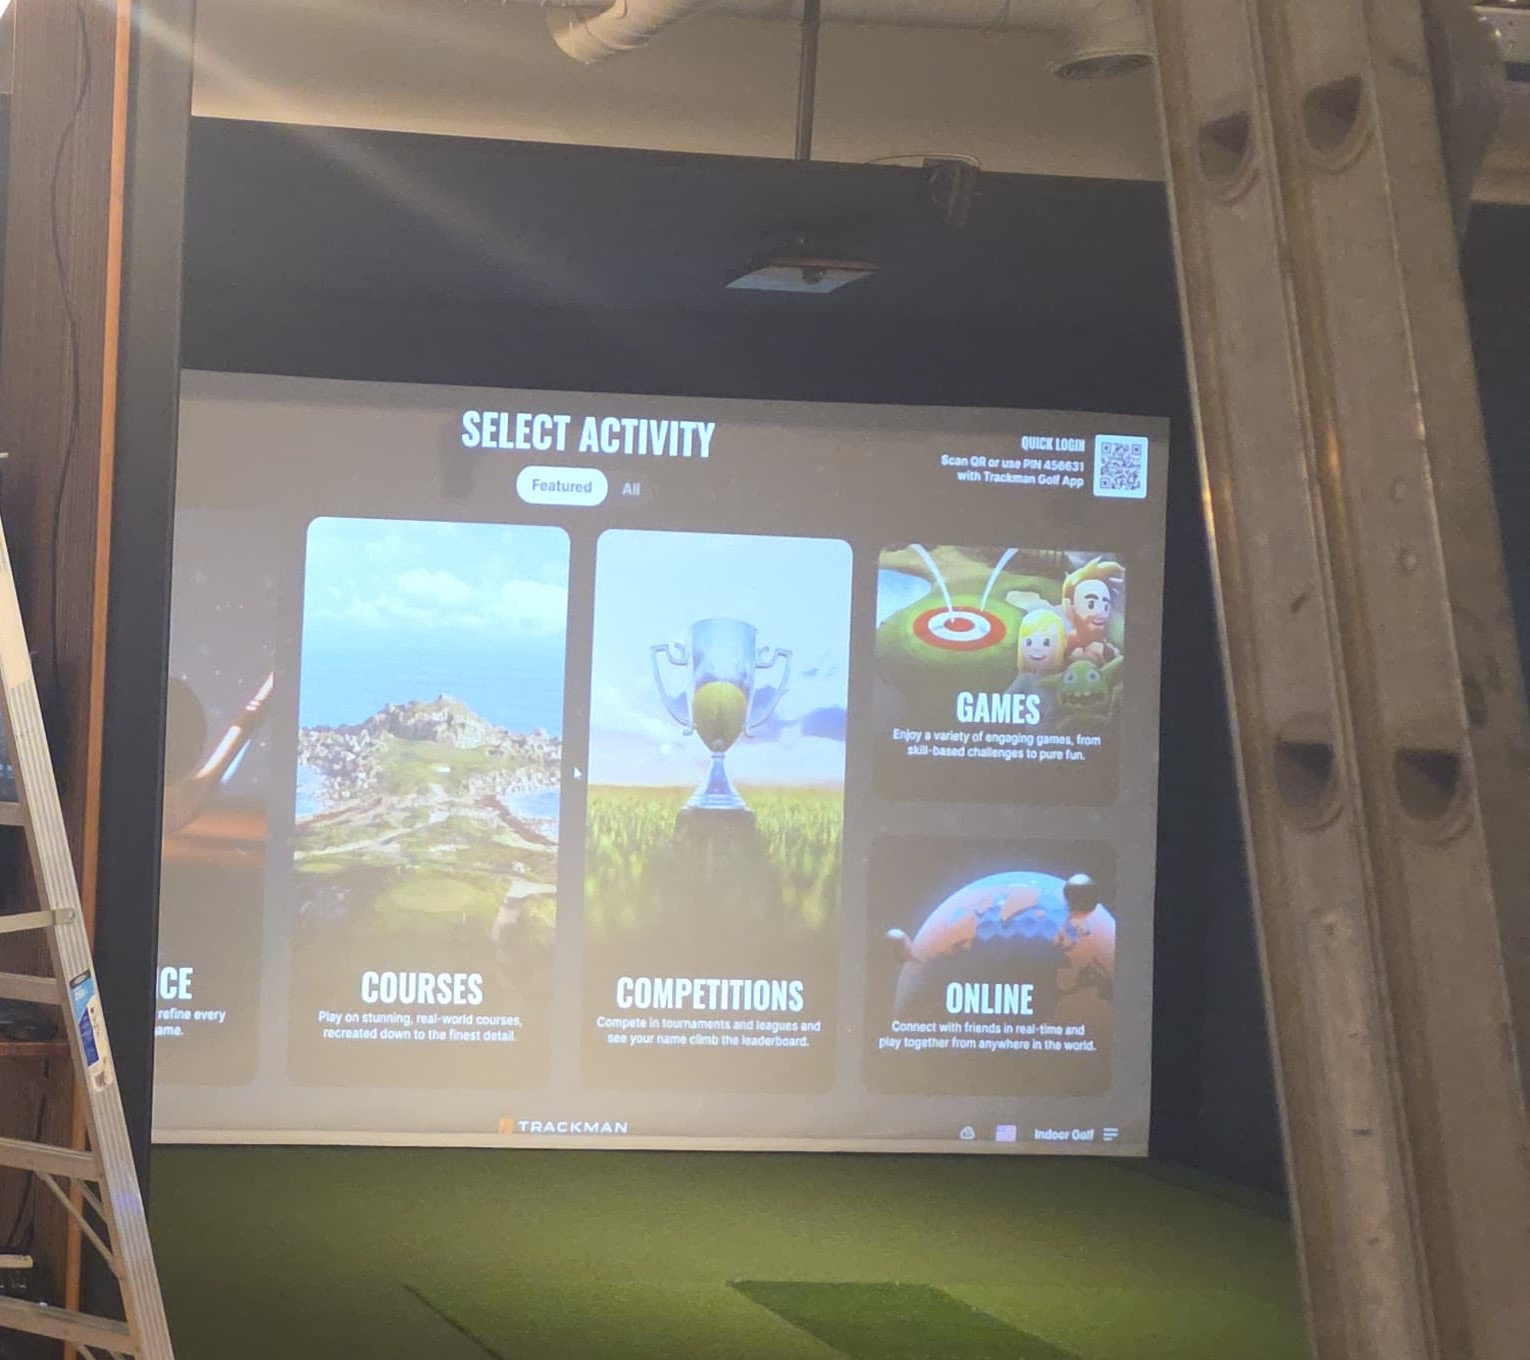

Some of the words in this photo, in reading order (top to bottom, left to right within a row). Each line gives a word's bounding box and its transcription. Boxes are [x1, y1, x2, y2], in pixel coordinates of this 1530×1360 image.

[461, 409, 571, 452] SELECT
[578, 416, 716, 459] ACTIVITY
[1021, 436, 1053, 452] QUICK
[1055, 438, 1086, 453] LOGIN
[941, 454, 968, 466] Scan
[970, 456, 987, 468] QR
[988, 459, 1000, 469] or
[1001, 460, 1021, 470] use
[1023, 459, 1042, 470] PIN
[532, 478, 593, 494] Featured
[622, 482, 640, 496] All
[957, 470, 981, 482] with
[983, 471, 1035, 485] Trackman
[1038, 474, 1060, 485] Golf
[1062, 475, 1084, 488] App
[956, 691, 1040, 725] GAMES
[893, 728, 922, 741] Enjoy
[925, 732, 931, 740] a
[933, 731, 970, 743] variety
[972, 731, 983, 742] of
[985, 733, 1034, 746] engaging
[1036, 734, 1074, 747] games,
[1076, 734, 1101, 745] from
[907, 745, 965, 757] skill-based
[966, 747, 1023, 761] challenges
[1026, 749, 1037, 758] to
[1039, 750, 1063, 762] pure
[1065, 749, 1085, 760] fun.
[361, 971, 483, 1005] COURSES
[616, 976, 804, 1012] COMPETITIONS
[945, 981, 1034, 1015] ONLINE
[158, 1007, 191, 1020] refine
[194, 1010, 226, 1023] every
[318, 1011, 342, 1024] Play
[345, 1014, 360, 1024] on
[362, 1012, 413, 1026] stunning,
[416, 1013, 473, 1025] real-world
[476, 1015, 522, 1027] courses,
[596, 1016, 646, 1031] Compete
[649, 1017, 660, 1028] in
[662, 1018, 731, 1030] tournaments
[733, 1019, 754, 1030] and
[755, 1020, 798, 1033] leagues
[800, 1021, 821, 1032] and
[891, 1021, 937, 1033] Connect
[939, 1022, 962, 1034] with
[964, 1022, 1001, 1034] friends
[1003, 1023, 1013, 1034] in
[1015, 1023, 1063, 1035] real-time
[1065, 1024, 1085, 1036] and
[323, 1028, 378, 1040] recreated
[380, 1028, 411, 1040] down
[414, 1030, 425, 1040] to
[428, 1029, 447, 1040] the
[448, 1029, 480, 1041] finest
[483, 1029, 518, 1042] detail.
[607, 1034, 627, 1044] see
[629, 1034, 654, 1046] your
[657, 1035, 687, 1045] name
[689, 1033, 719, 1045] climb
[721, 1034, 739, 1046] the
[741, 1034, 809, 1047] leaderboard.
[879, 1036, 902, 1049] play
[904, 1037, 949, 1050] together
[951, 1037, 976, 1049] from
[978, 1039, 1030, 1052] anywhere
[1033, 1039, 1042, 1050] in
[1045, 1039, 1062, 1050] the
[1064, 1040, 1097, 1051] world.
[518, 1120, 628, 1134] TRACKMAN
[1034, 1128, 1070, 1140] Indoor
[1072, 1128, 1094, 1140] Golf
